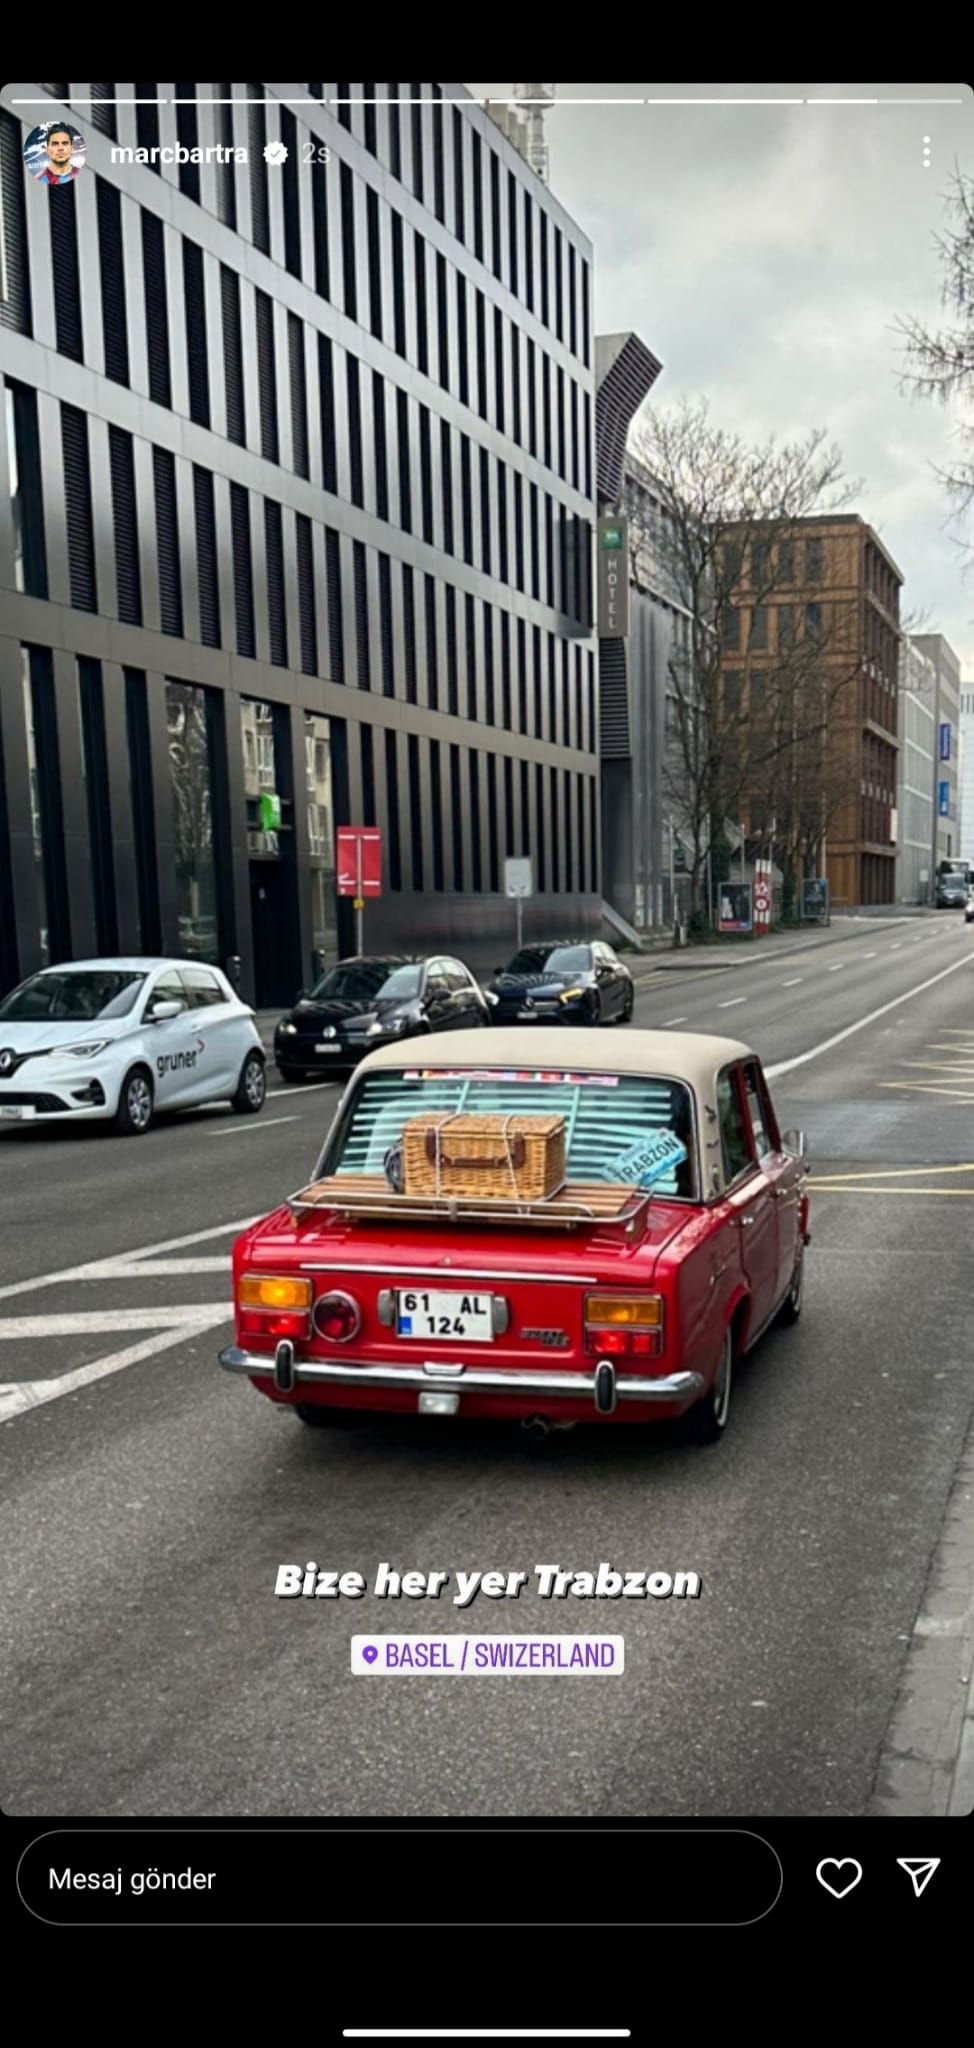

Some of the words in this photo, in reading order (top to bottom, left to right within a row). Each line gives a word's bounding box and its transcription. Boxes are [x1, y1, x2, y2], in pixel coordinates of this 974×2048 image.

[607, 559, 618, 630] HOTEL
[156, 1050, 197, 1079] gruner
[612, 1137, 681, 1184] TRABZON
[404, 1293, 430, 1312] 61
[460, 1296, 487, 1315] AL
[427, 1316, 465, 1335] 124
